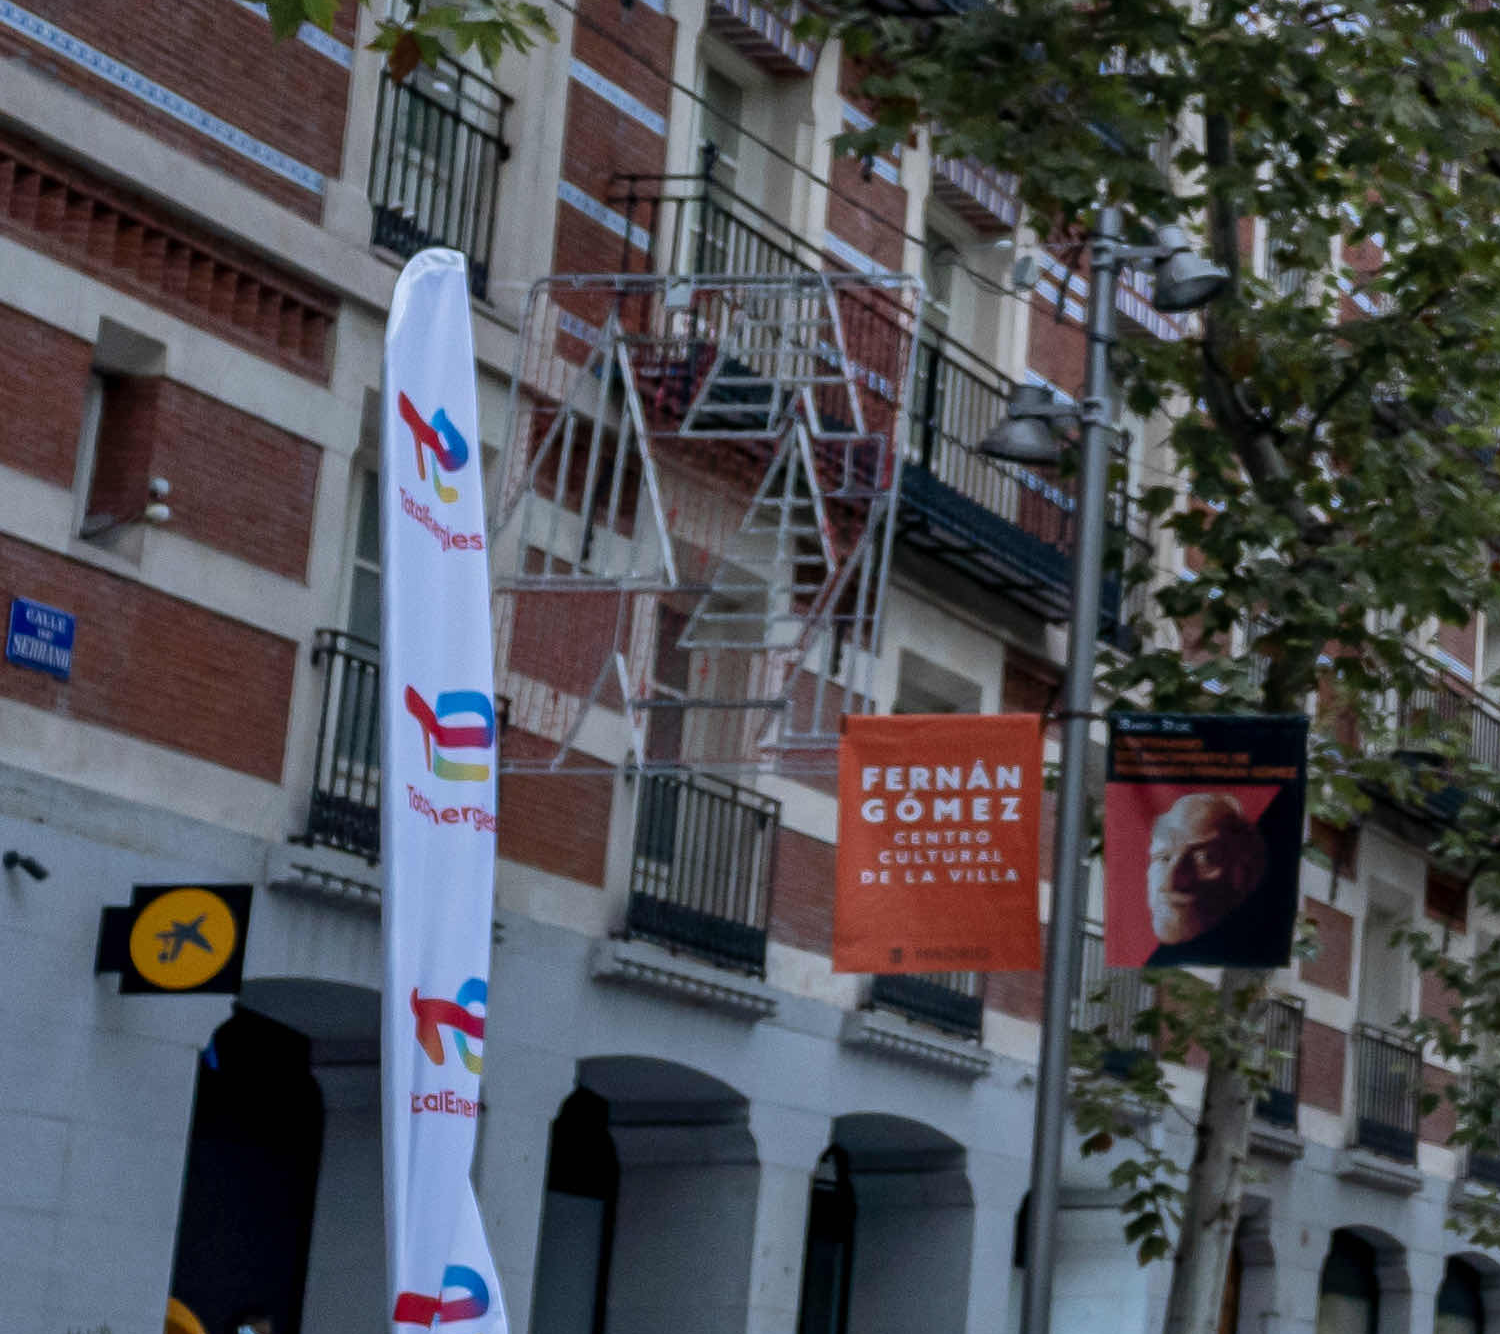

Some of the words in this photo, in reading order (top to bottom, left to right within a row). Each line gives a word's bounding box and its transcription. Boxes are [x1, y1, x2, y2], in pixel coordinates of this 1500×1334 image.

[25, 609, 67, 635] CALLE
[14, 634, 72, 669] SERRANO
[861, 758, 1022, 792] FERNÁN
[861, 792, 1021, 823] GÓMEZ
[893, 830, 991, 845] CENTRO
[879, 849, 1003, 864] CULTURAL
[861, 870, 890, 884] DE
[905, 870, 935, 884] LA
[950, 868, 1019, 883] VILLA
